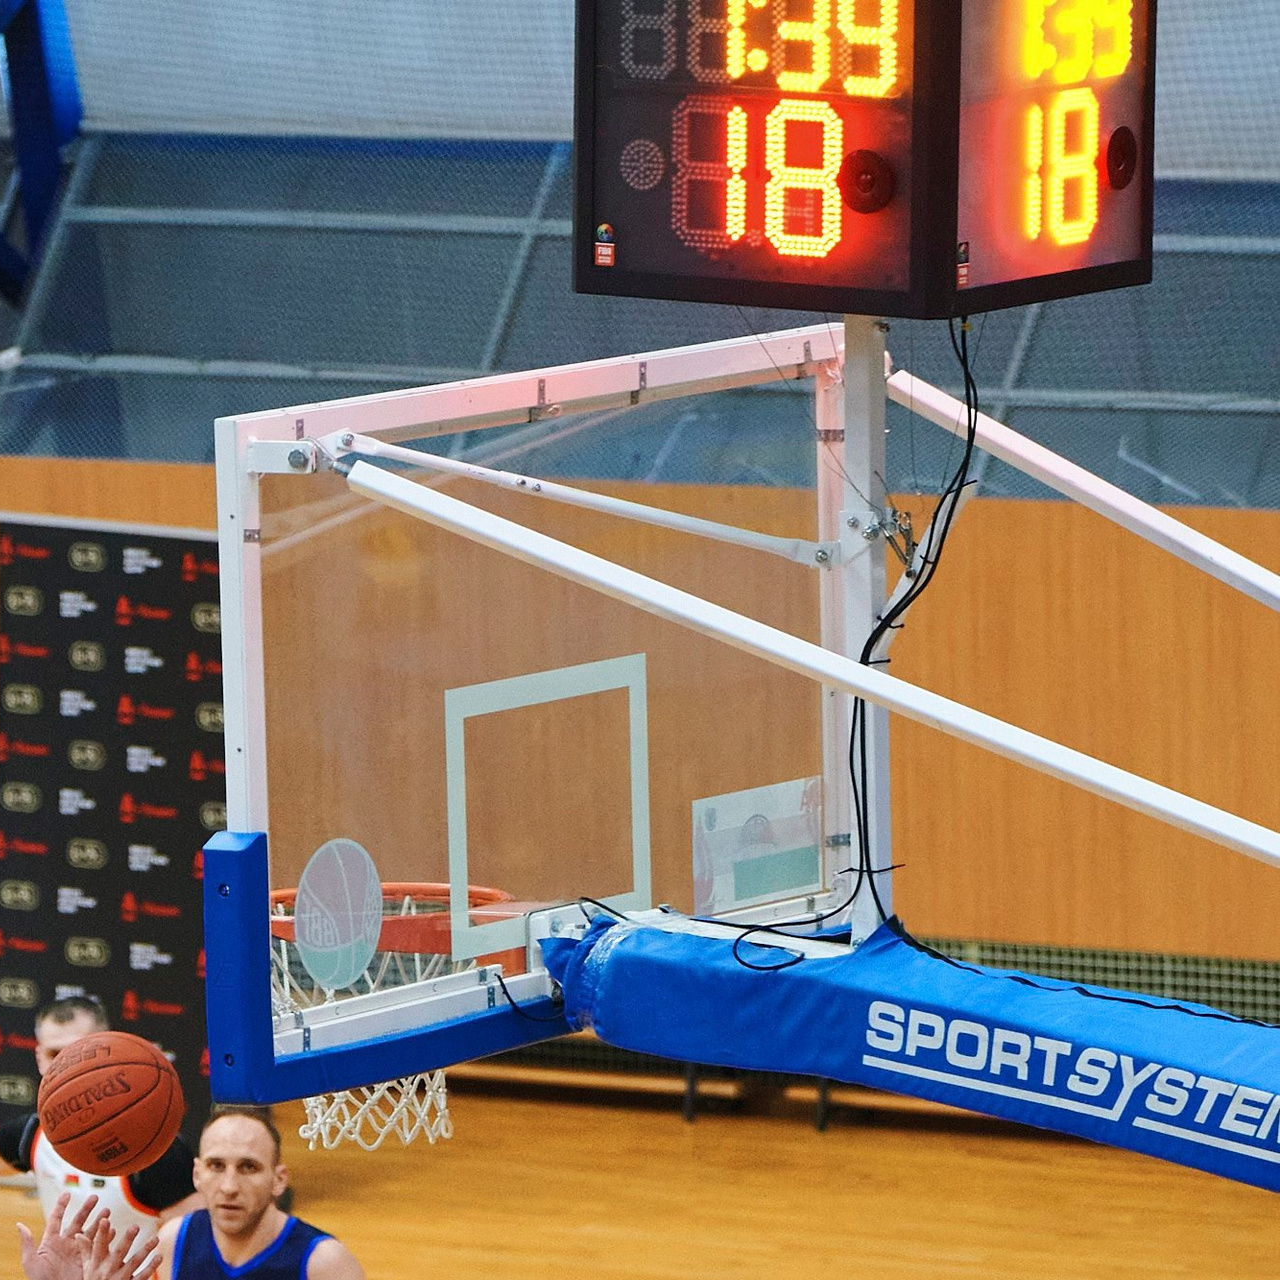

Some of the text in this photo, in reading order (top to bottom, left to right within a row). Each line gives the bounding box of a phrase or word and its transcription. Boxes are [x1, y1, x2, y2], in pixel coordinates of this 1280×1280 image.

[726, 98, 843, 258] 18
[1024, 87, 1100, 246] 18
[44, 1071, 131, 1131] SPALDING
